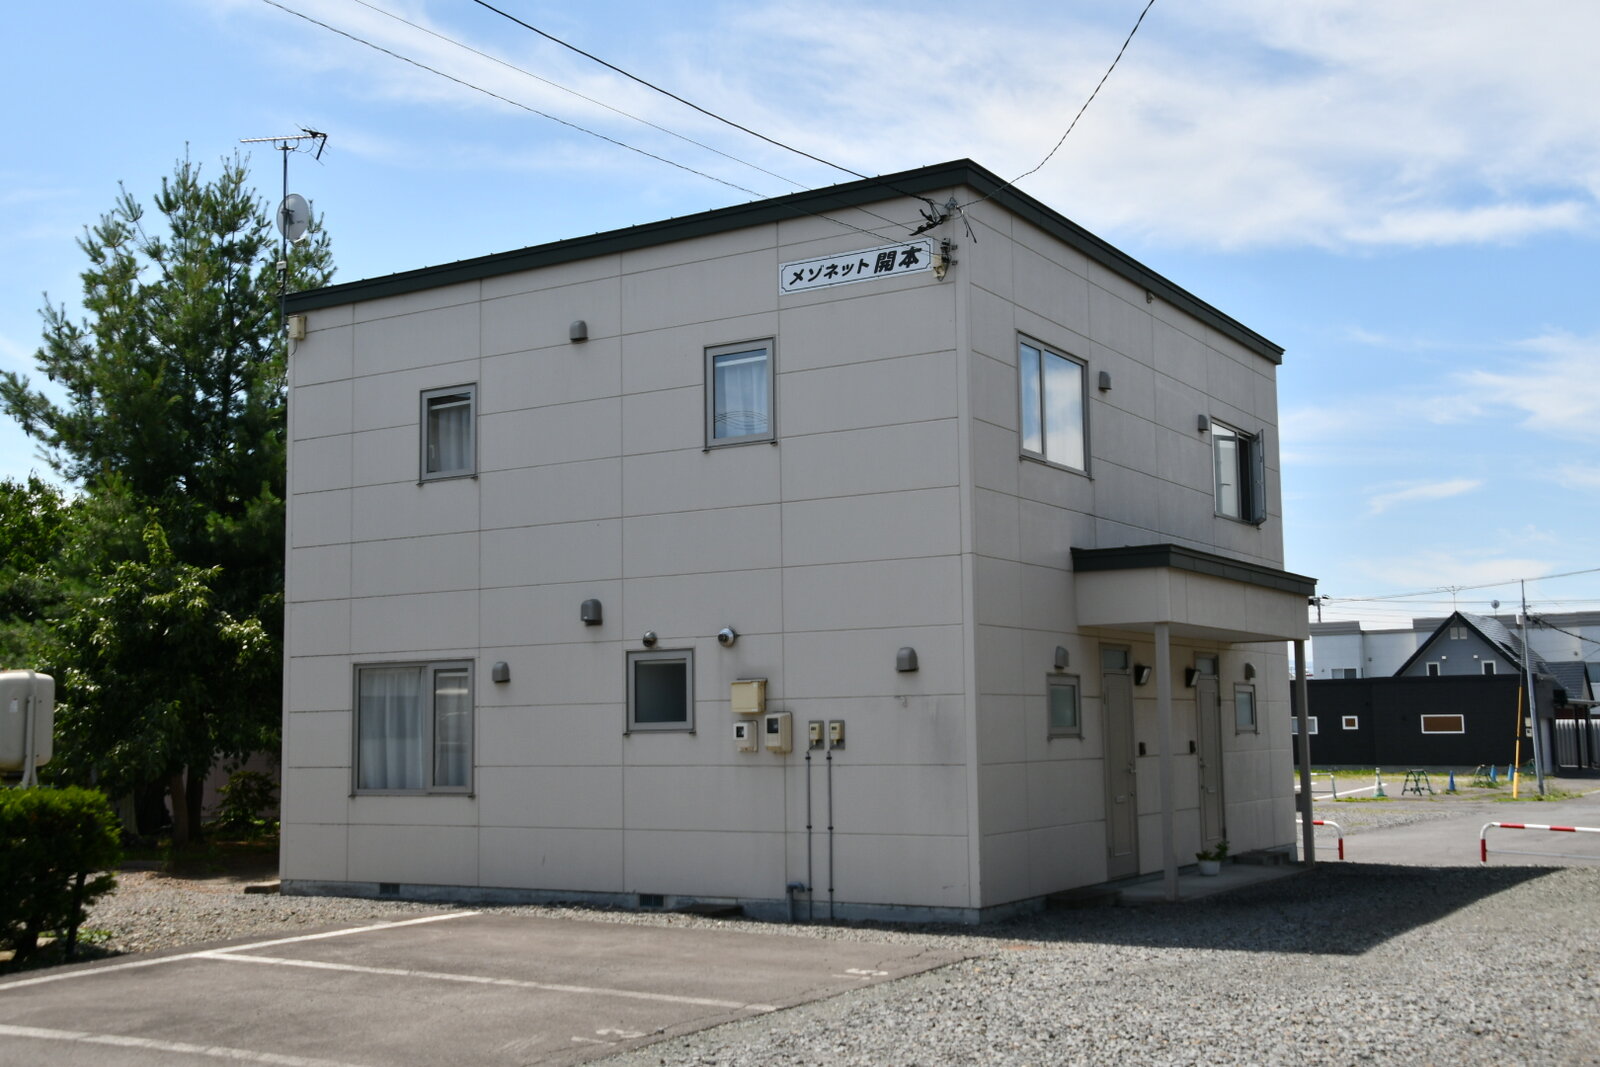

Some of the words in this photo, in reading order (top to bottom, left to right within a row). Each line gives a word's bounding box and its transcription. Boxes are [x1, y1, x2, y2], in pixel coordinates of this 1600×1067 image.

[789, 246, 922, 285] メゾネット開本
